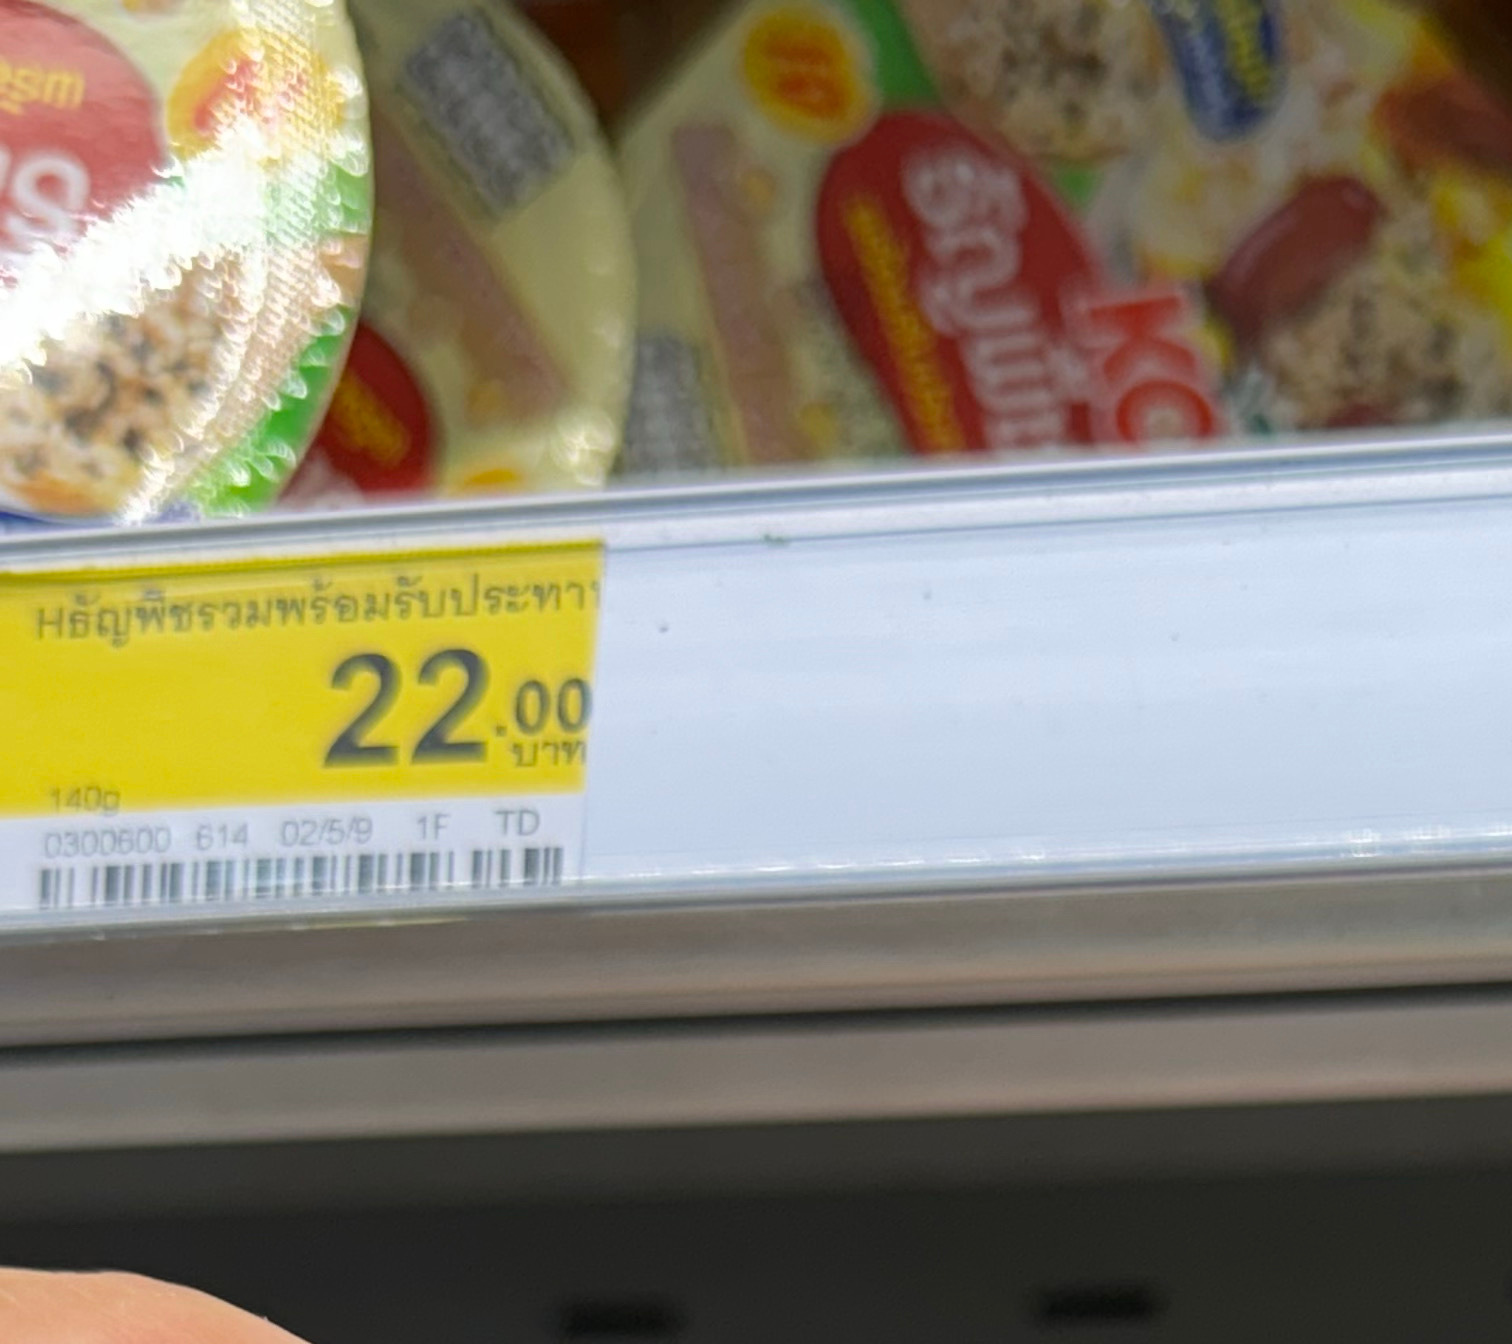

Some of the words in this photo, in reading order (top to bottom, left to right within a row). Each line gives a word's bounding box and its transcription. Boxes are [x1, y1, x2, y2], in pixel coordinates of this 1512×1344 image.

[36, 573, 601, 650] Hธัญพืชรวมพร้อมรับประทา
[509, 738, 586, 768] บาท
[49, 786, 122, 818] 140g
[44, 823, 172, 860] 0300600
[194, 821, 249, 853] 614
[279, 811, 374, 848] 02/5/9
[416, 812, 452, 842] 1F
[495, 808, 541, 839] TD
